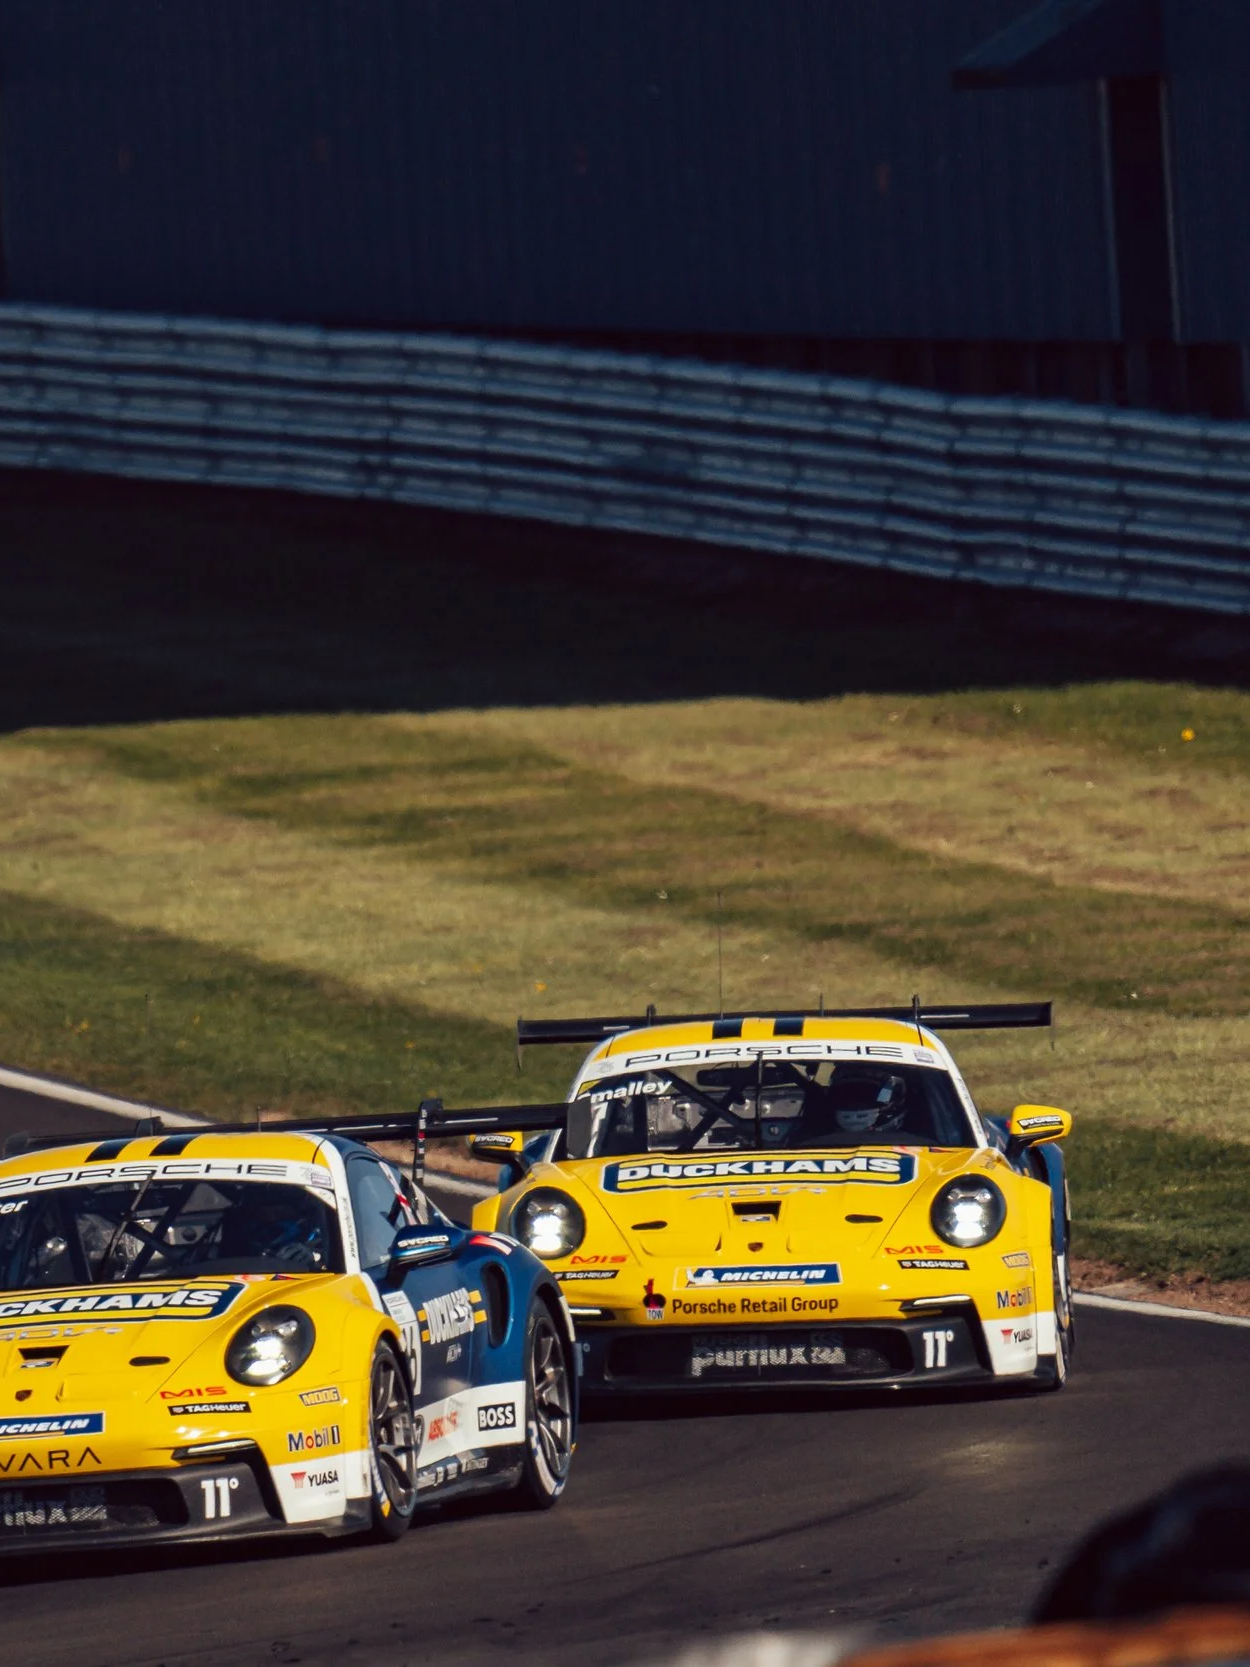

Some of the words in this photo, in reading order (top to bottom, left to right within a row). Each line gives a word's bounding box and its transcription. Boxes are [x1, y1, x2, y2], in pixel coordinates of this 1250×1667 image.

[625, 1044, 903, 1068] PORSCHE
[617, 1156, 901, 1182] DUCKHAMS
[885, 1245, 944, 1255] MIS
[570, 1255, 627, 1264] MIS
[720, 1268, 827, 1282] MICHELIN
[672, 1299, 736, 1314] Porsche
[741, 1297, 787, 1313] Retail
[791, 1296, 839, 1313] Group
[160, 1386, 227, 1400] MIS
[478, 1405, 514, 1429] BOSS
[288, 1427, 329, 1452] Mobil
[307, 1469, 340, 1487] YUASA
